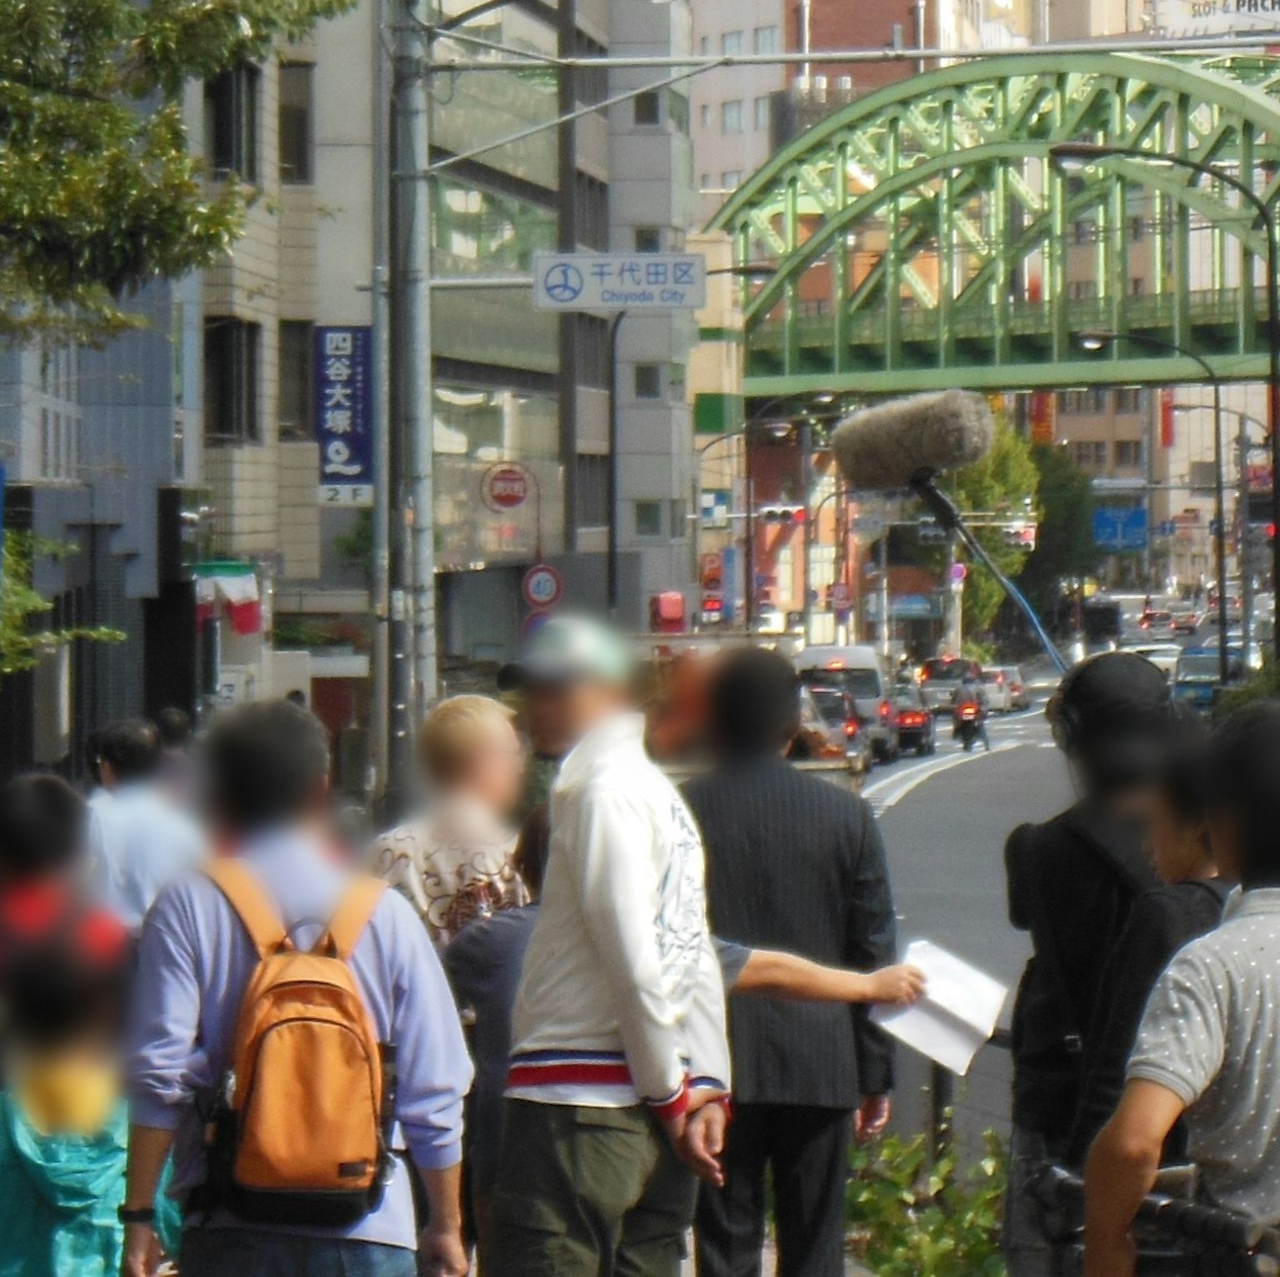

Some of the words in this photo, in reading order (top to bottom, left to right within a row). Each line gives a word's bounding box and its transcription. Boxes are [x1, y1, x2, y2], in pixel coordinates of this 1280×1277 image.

[1191, 1, 1219, 19] SLOT
[592, 262, 695, 286] 千代田区
[601, 290, 654, 304] Chiyoda
[660, 289, 686, 304] City
[325, 332, 353, 434] 四谷大塚
